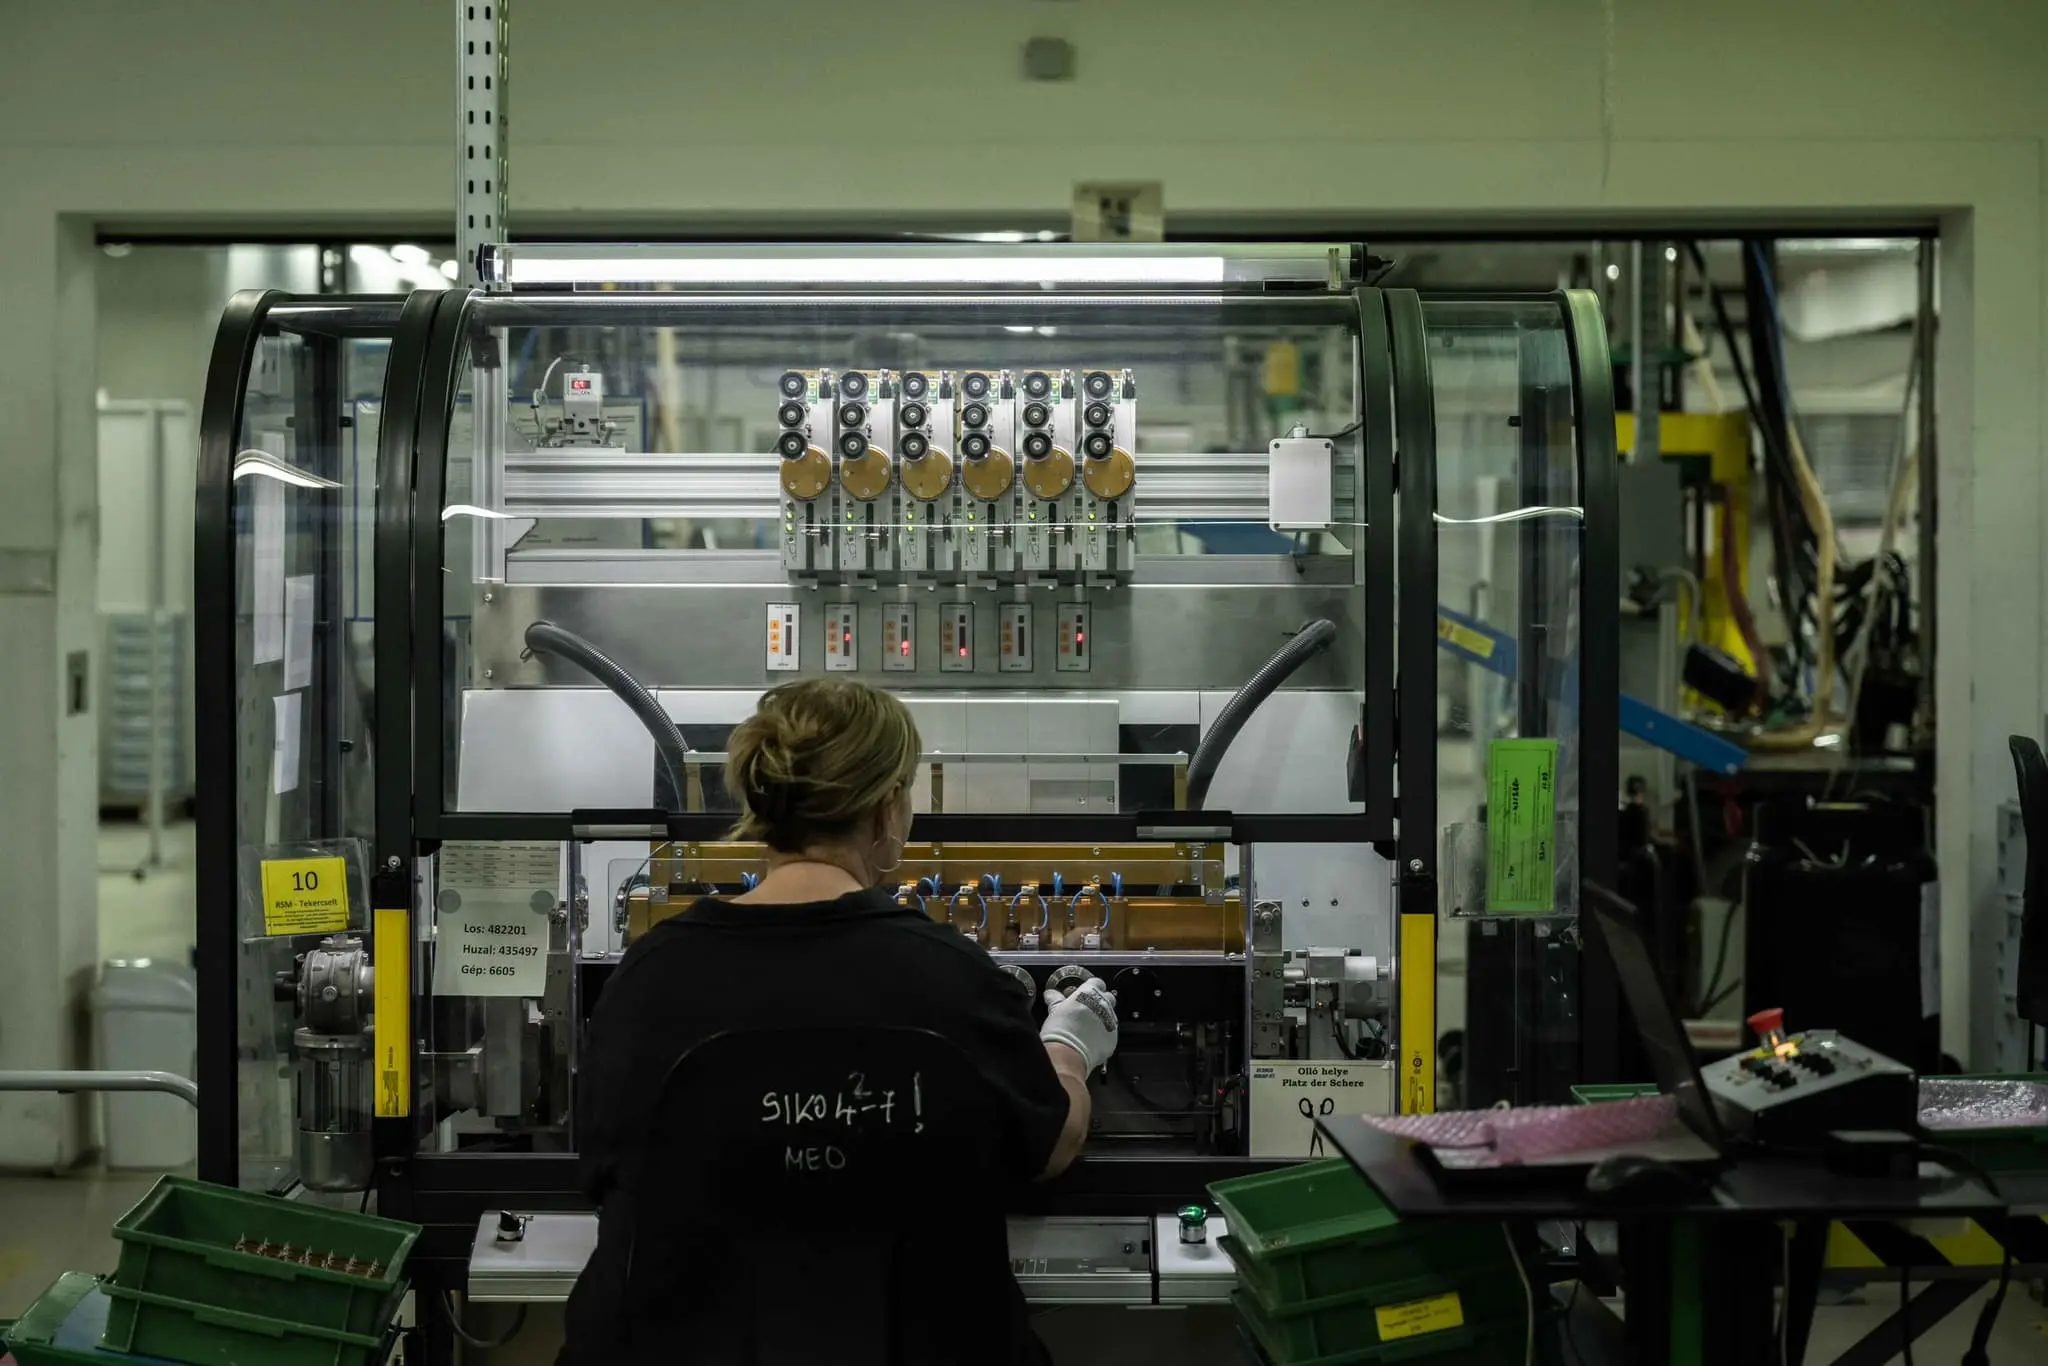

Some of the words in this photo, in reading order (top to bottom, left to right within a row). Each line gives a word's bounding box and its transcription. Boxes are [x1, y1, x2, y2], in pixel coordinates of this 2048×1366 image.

[292, 871, 319, 891] 10
[464, 923, 485, 934] Los:
[488, 924, 527, 935] 482201
[463, 944, 496, 955] Huzal:
[498, 945, 538, 957] 435497
[461, 964, 486, 977] Gép:
[489, 966, 515, 976] 6605
[1297, 1067, 1318, 1076] Olló
[1321, 1067, 1349, 1077] helye
[1282, 1078, 1307, 1087] Platz
[1310, 1078, 1327, 1087] der
[1329, 1078, 1364, 1087] Schere
